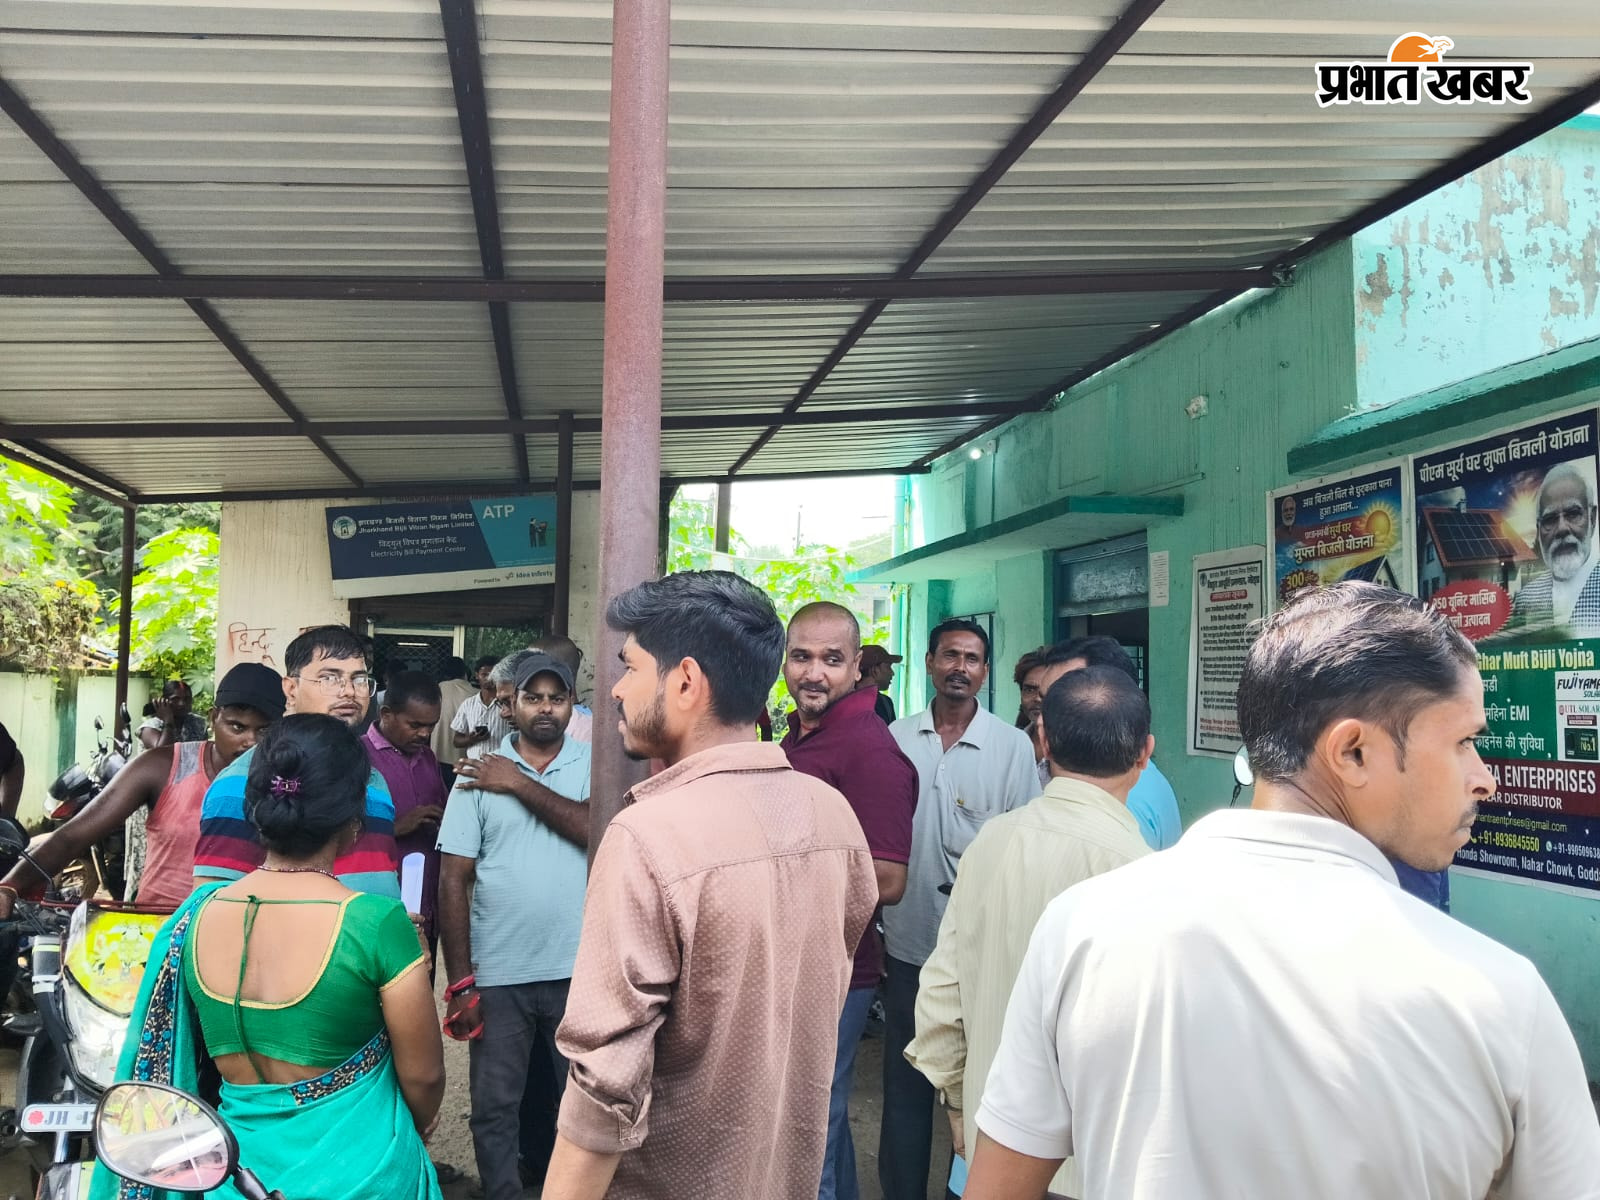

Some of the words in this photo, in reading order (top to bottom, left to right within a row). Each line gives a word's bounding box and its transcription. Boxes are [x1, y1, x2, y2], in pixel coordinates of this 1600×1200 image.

[1419, 462, 1444, 483] पीएम
[1447, 453, 1465, 482] सूर्य
[1466, 453, 1482, 471] घर
[1483, 445, 1507, 473] मुफ्त
[1508, 431, 1547, 462] बिजली
[1549, 424, 1590, 450] योजना
[482, 504, 515, 519] ATP
[358, 525, 393, 534] Jharkhand
[429, 522, 449, 531] Nigam
[370, 549, 403, 558] Electricity
[403, 548, 414, 556] Bill
[415, 547, 442, 556] Payment
[1317, 537, 1345, 557] बिजली
[1345, 534, 1374, 551] योजना
[1448, 592, 1468, 612] यूनिट
[1469, 589, 1497, 606] मासिक
[1476, 652, 1501, 671] Ghar
[1503, 651, 1530, 670] Muft
[1531, 648, 1557, 671] Bijli
[1558, 648, 1595, 669] Yojna
[1510, 705, 1530, 721] EMI
[1504, 731, 1516, 750] की
[1504, 765, 1596, 794] ENTERPRISES
[1504, 792, 1563, 810] DISTRIBUTOR
[1479, 848, 1520, 869] Showroom,
[1521, 856, 1544, 873] Nahar
[1546, 860, 1576, 880] Chowk,
[45, 1110, 69, 1125] JH
